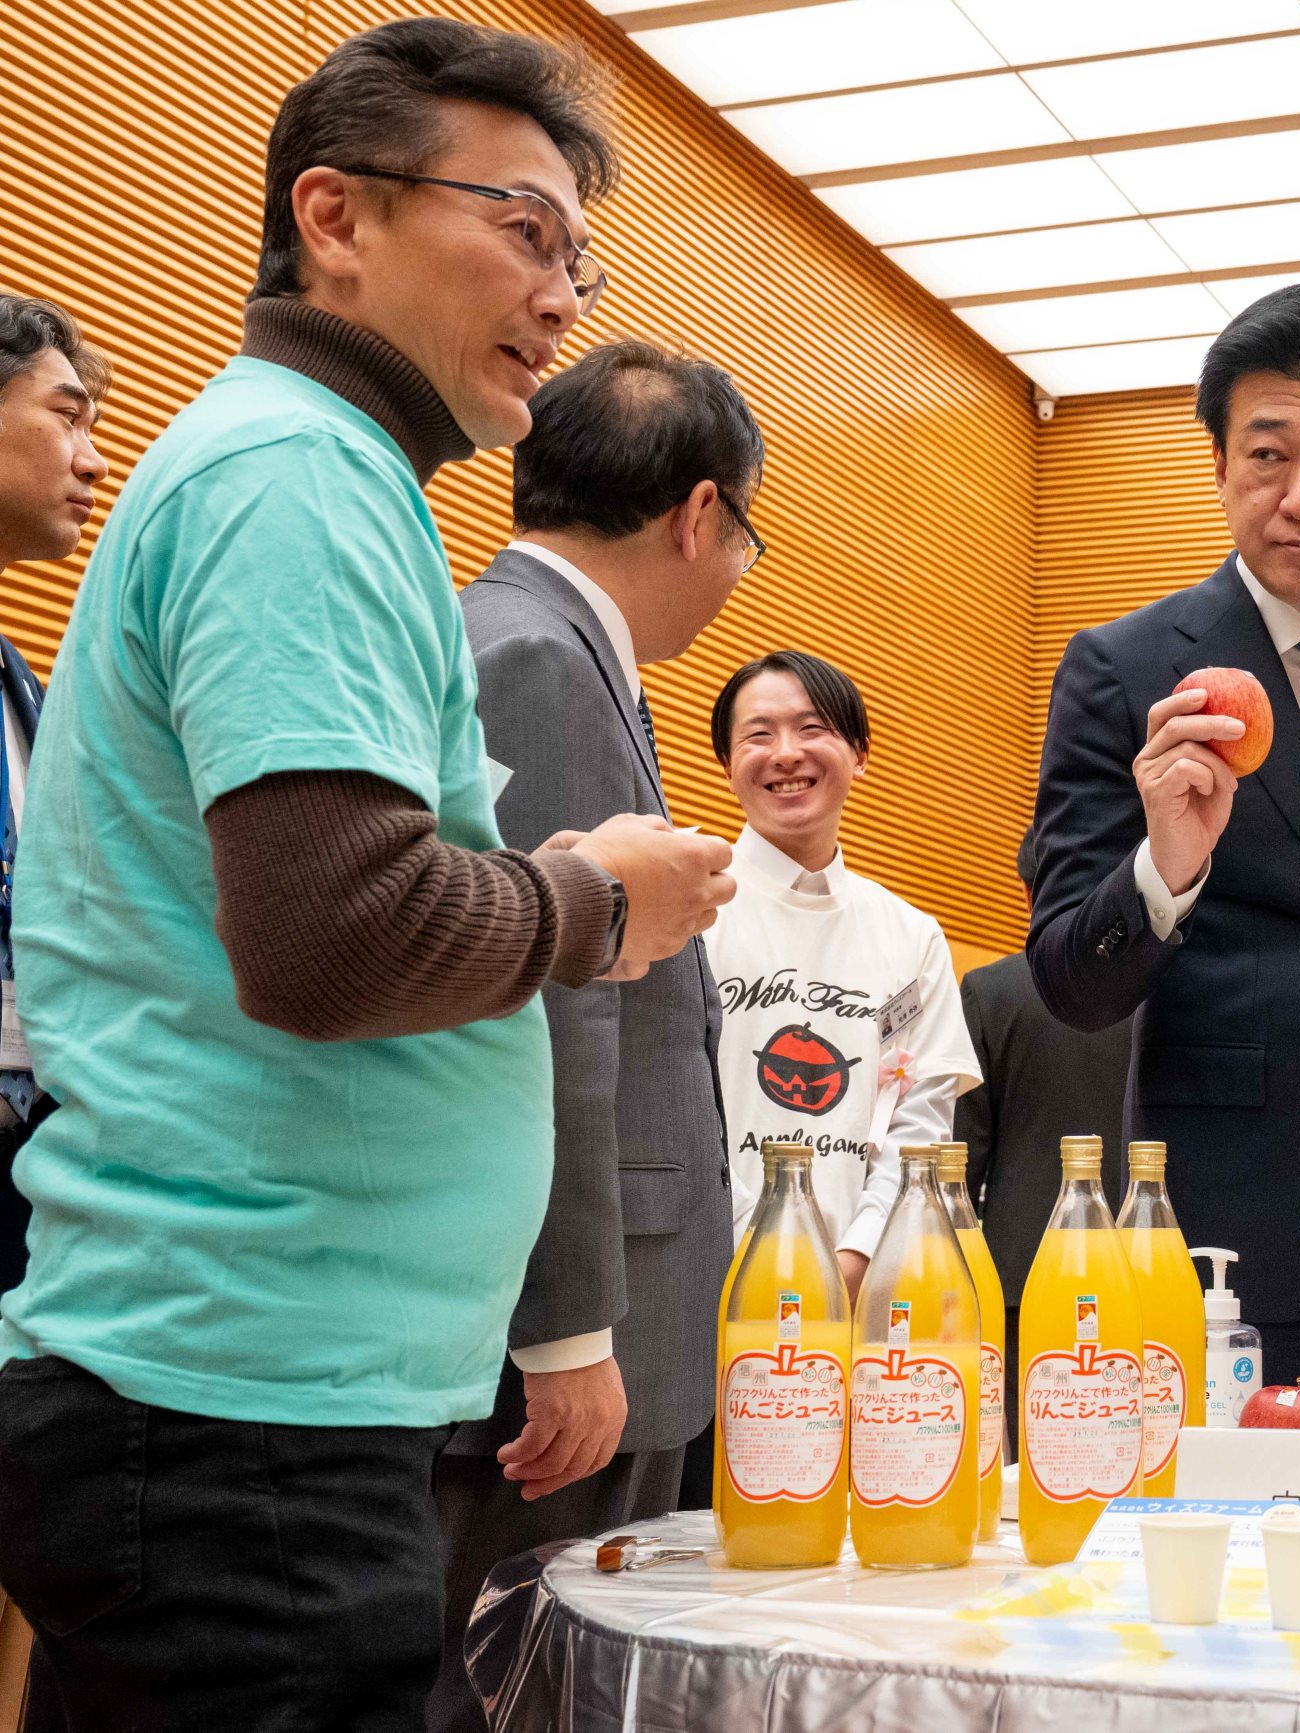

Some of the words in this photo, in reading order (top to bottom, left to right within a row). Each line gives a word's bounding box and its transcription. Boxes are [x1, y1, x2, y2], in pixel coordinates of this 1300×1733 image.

[717, 968, 800, 1015] With
[801, 981, 878, 1021] Far
[729, 1387, 830, 1400] ノウフクりんごで作った
[852, 1392, 941, 1405] ウフクりんごで作った
[1030, 1386, 1129, 1400] ノウフクりんごで作った
[729, 1400, 841, 1419] りんごジュース
[1031, 1399, 1140, 1420] りんごジュース
[1147, 1502, 1263, 1515] ウィズファーム
